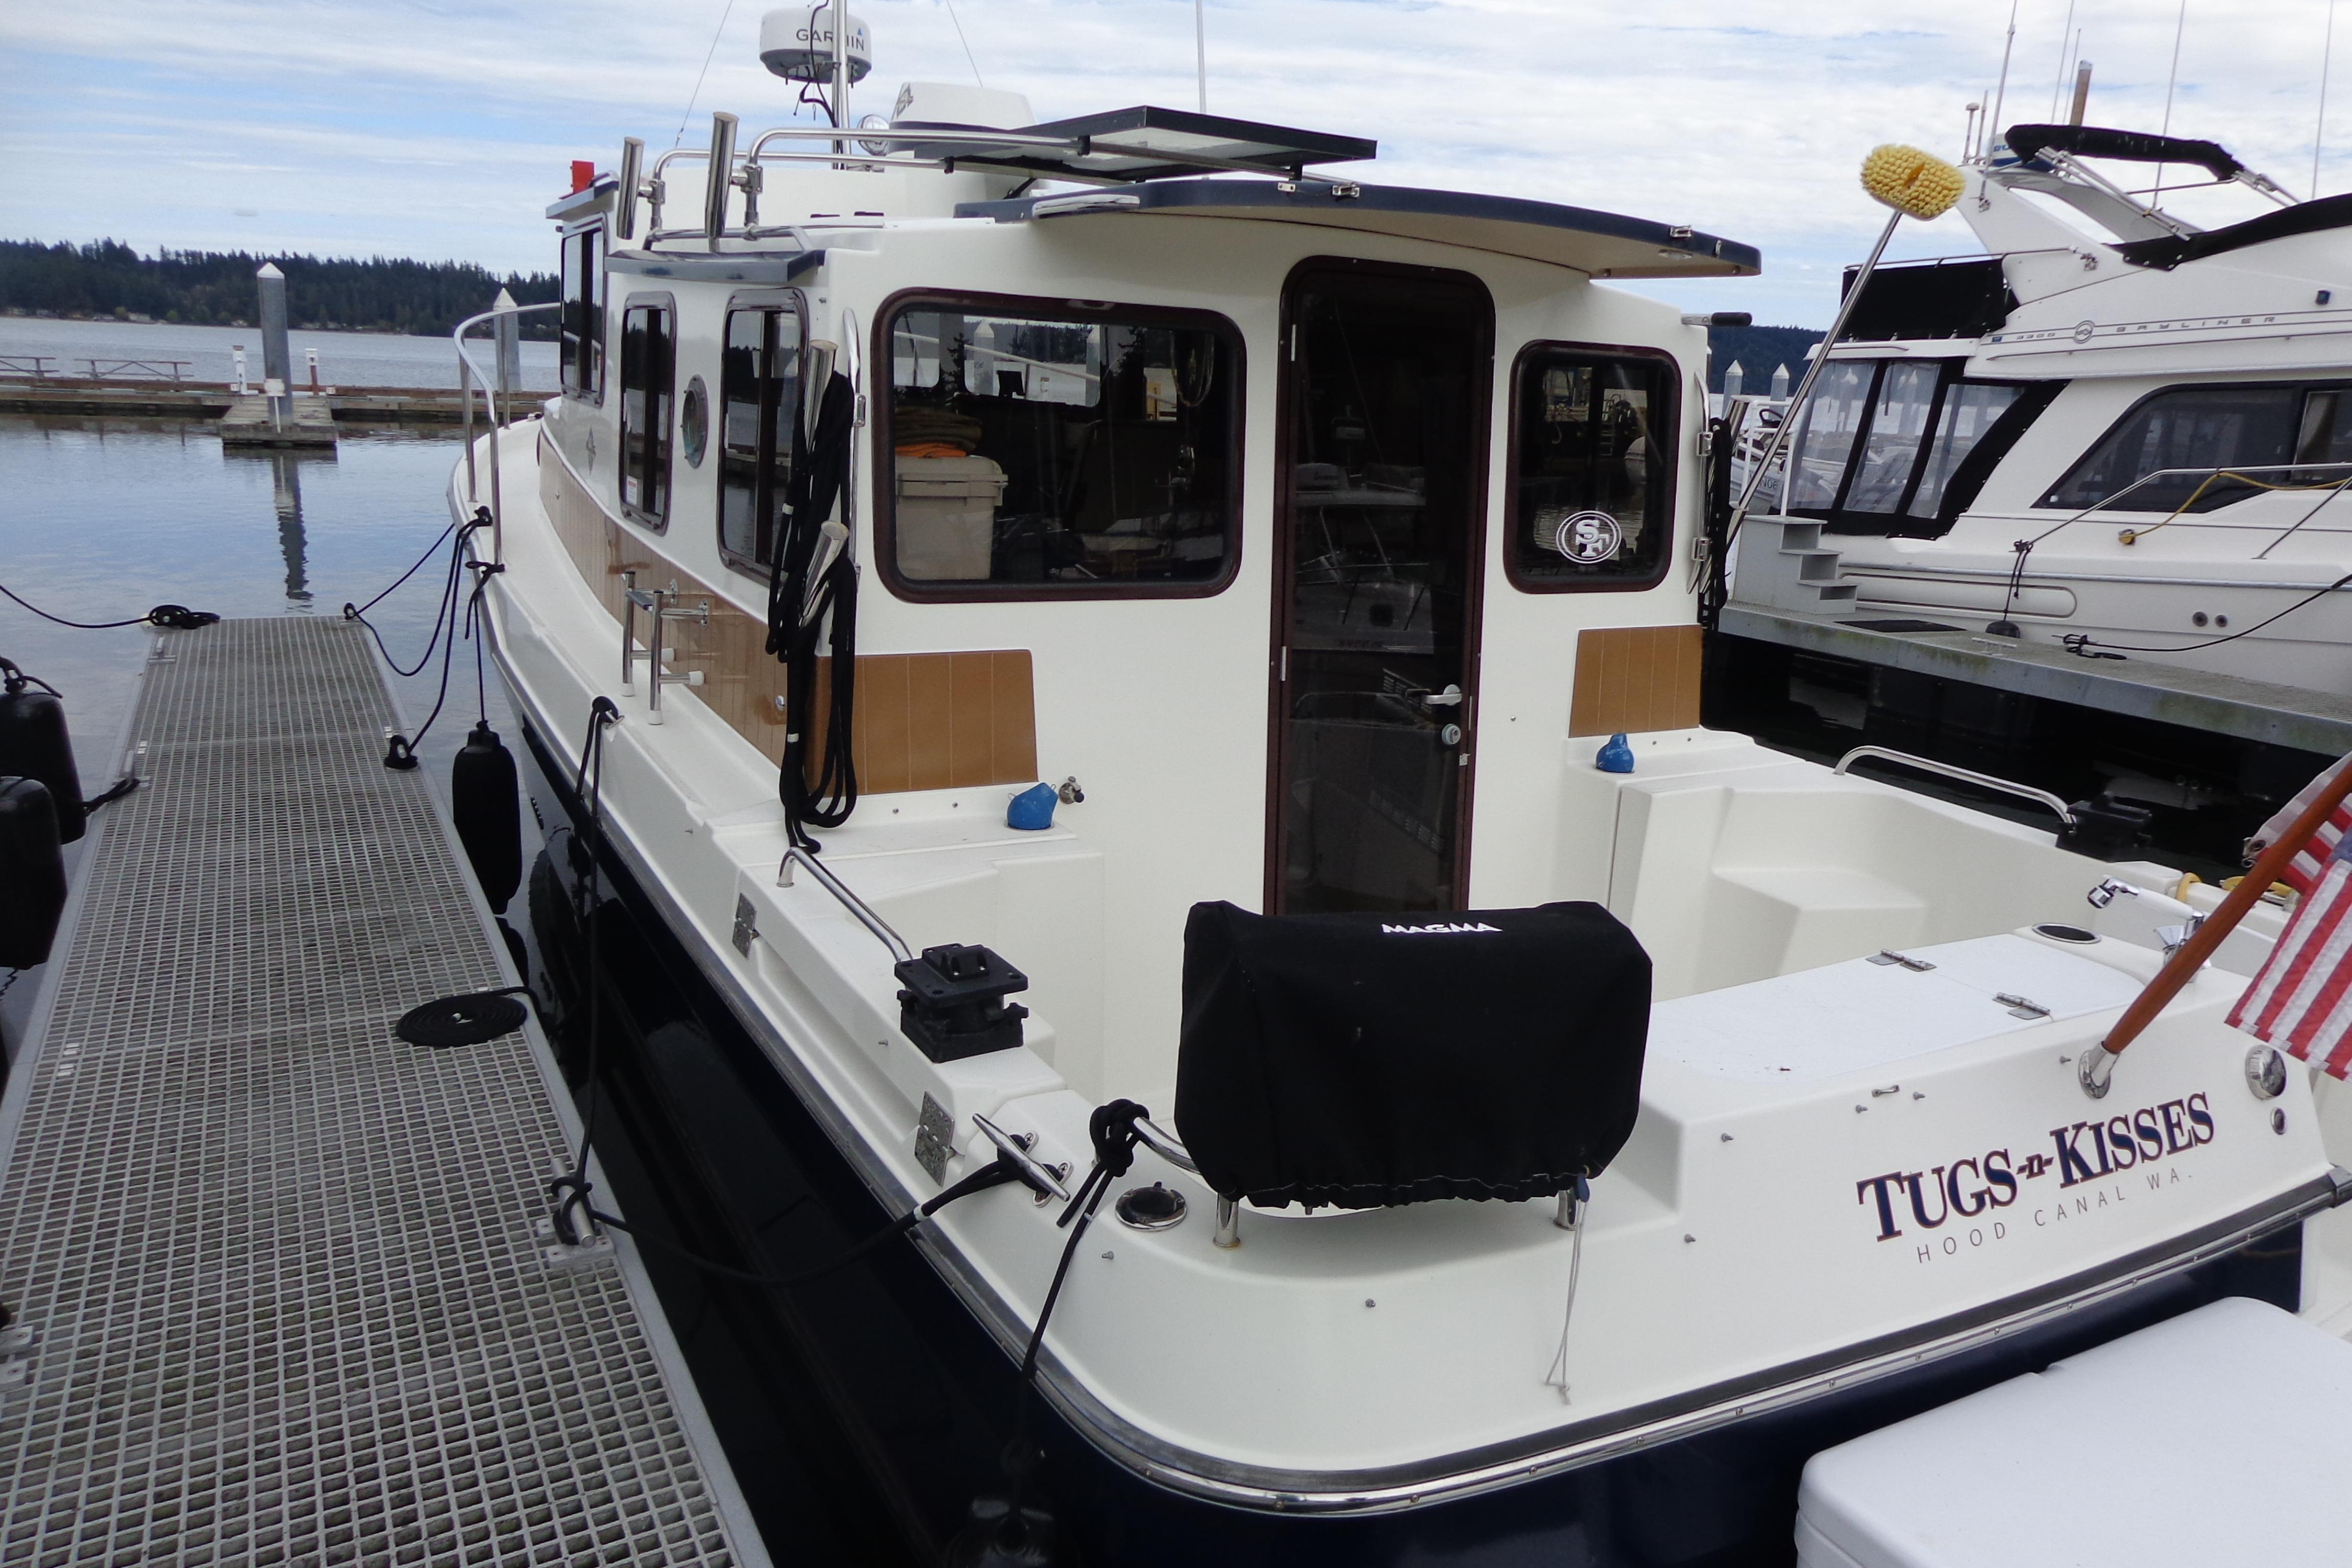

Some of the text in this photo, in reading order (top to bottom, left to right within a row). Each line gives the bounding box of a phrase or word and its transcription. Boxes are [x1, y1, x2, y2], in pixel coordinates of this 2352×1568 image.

[796, 29, 864, 51] GARIN
[2116, 316, 2275, 332] BAYLINER
[1381, 922, 1503, 934] MAGMA
[1917, 1167, 2193, 1264] HOOD CANAL WA.
